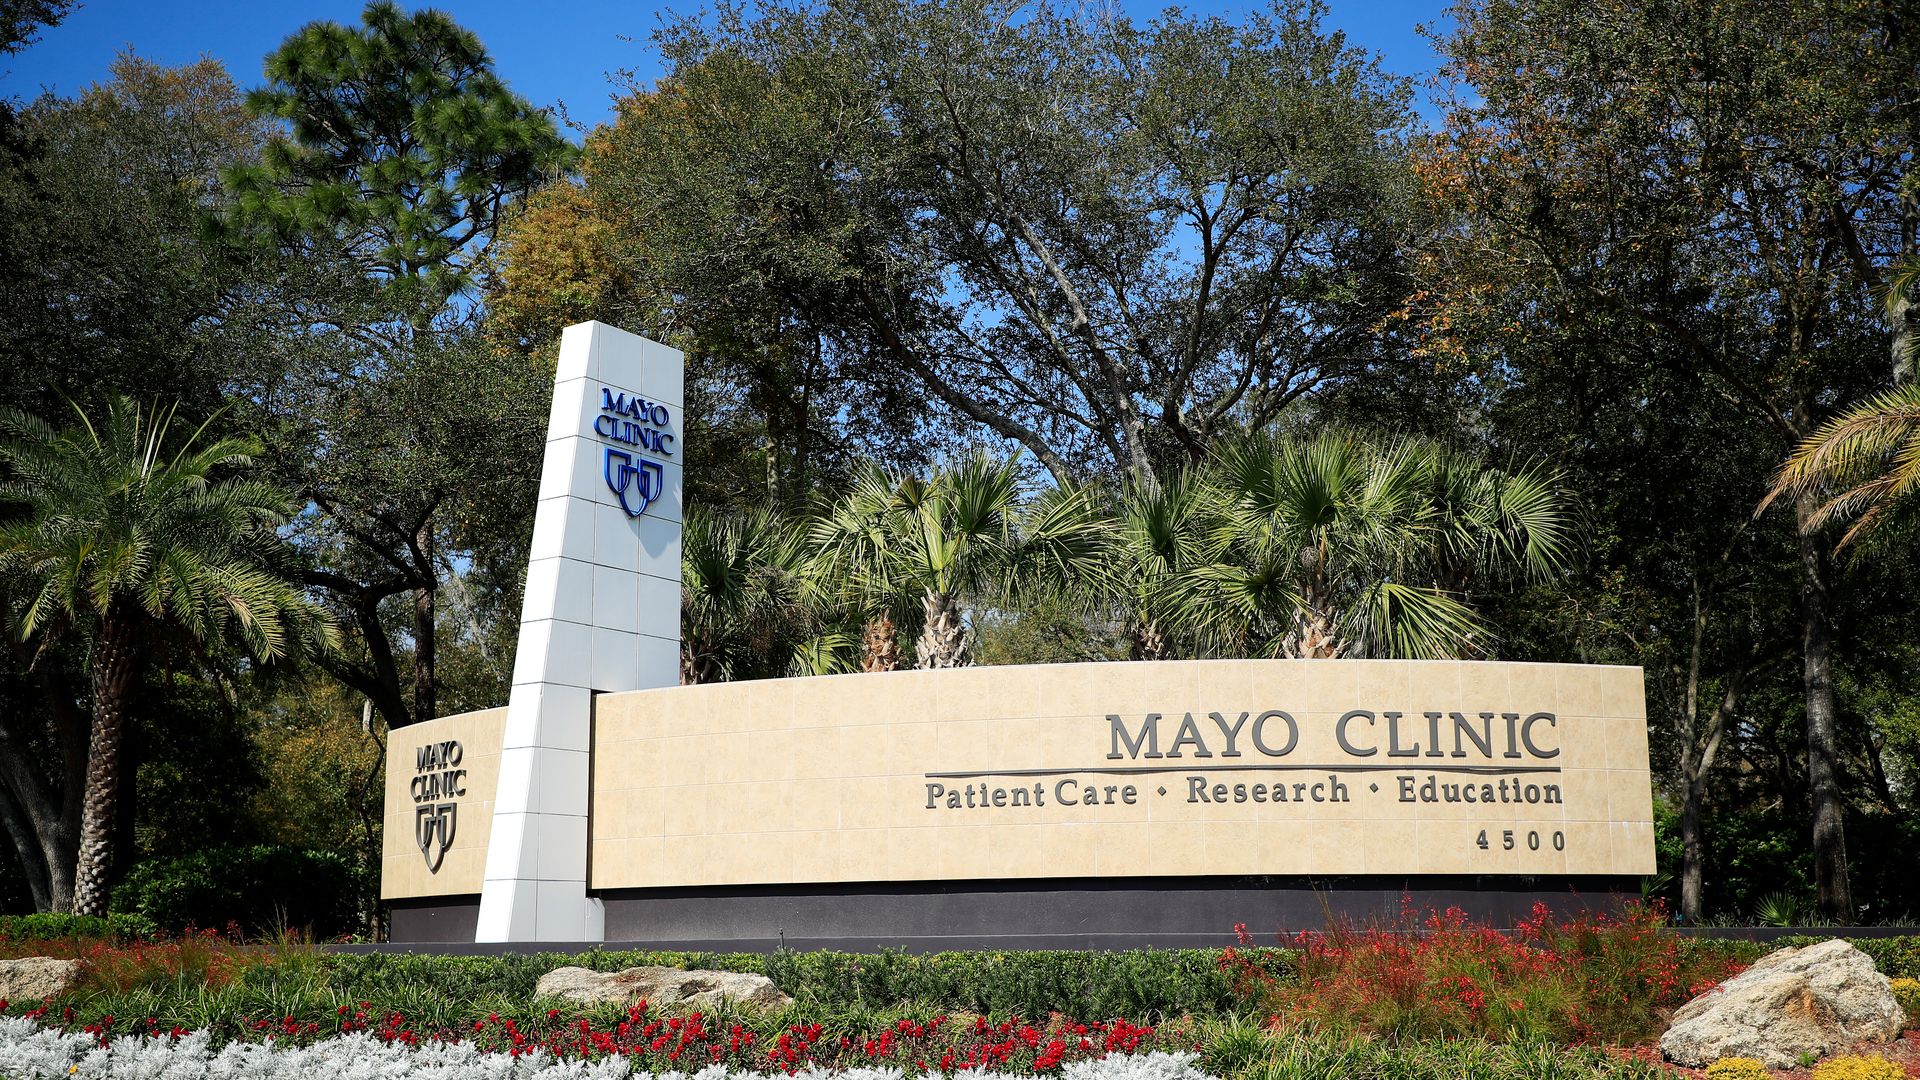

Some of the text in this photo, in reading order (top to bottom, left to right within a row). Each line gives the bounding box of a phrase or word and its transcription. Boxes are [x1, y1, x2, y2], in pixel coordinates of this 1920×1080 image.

[602, 387, 669, 427] MAYO
[594, 415, 674, 456] CLINIC
[1106, 710, 1560, 758] MAYO CLINIC
[416, 740, 463, 774] MAYO
[410, 769, 467, 803] CLINIC
[925, 775, 1562, 809] Patient Care Research Education
